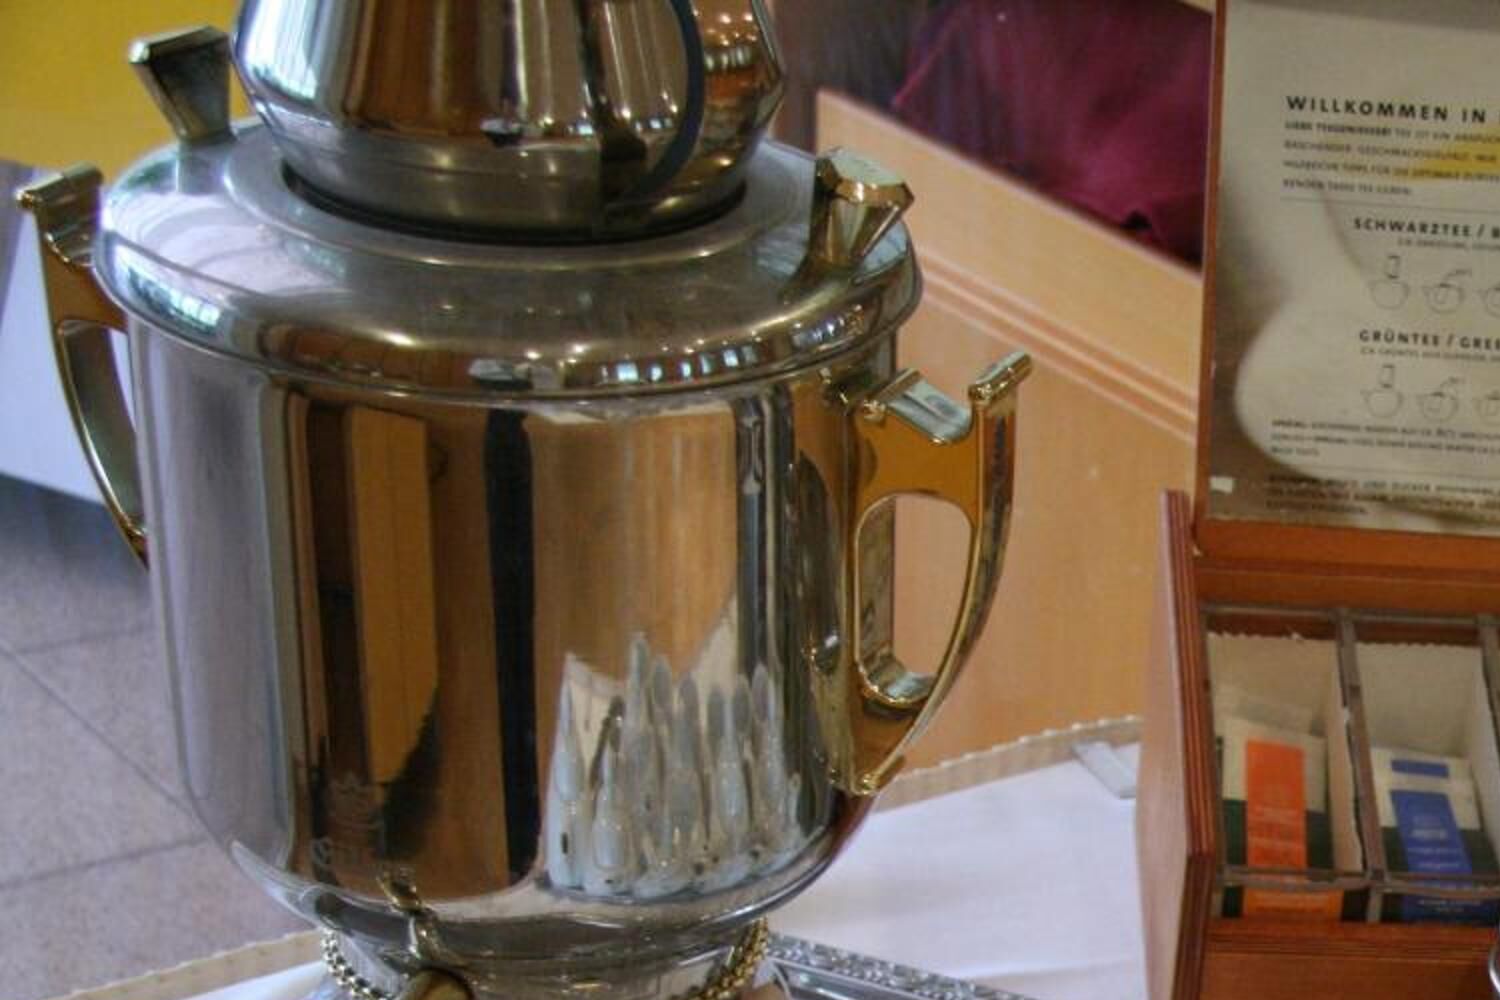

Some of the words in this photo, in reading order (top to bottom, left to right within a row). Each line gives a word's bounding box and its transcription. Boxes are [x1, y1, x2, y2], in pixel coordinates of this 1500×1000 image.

[1285, 95, 1449, 122] WILLKOMMEN
[1461, 109, 1487, 125] IN
[1354, 217, 1471, 238] SCHWARZTEE
[1359, 328, 1440, 348] GRÜNTEE
